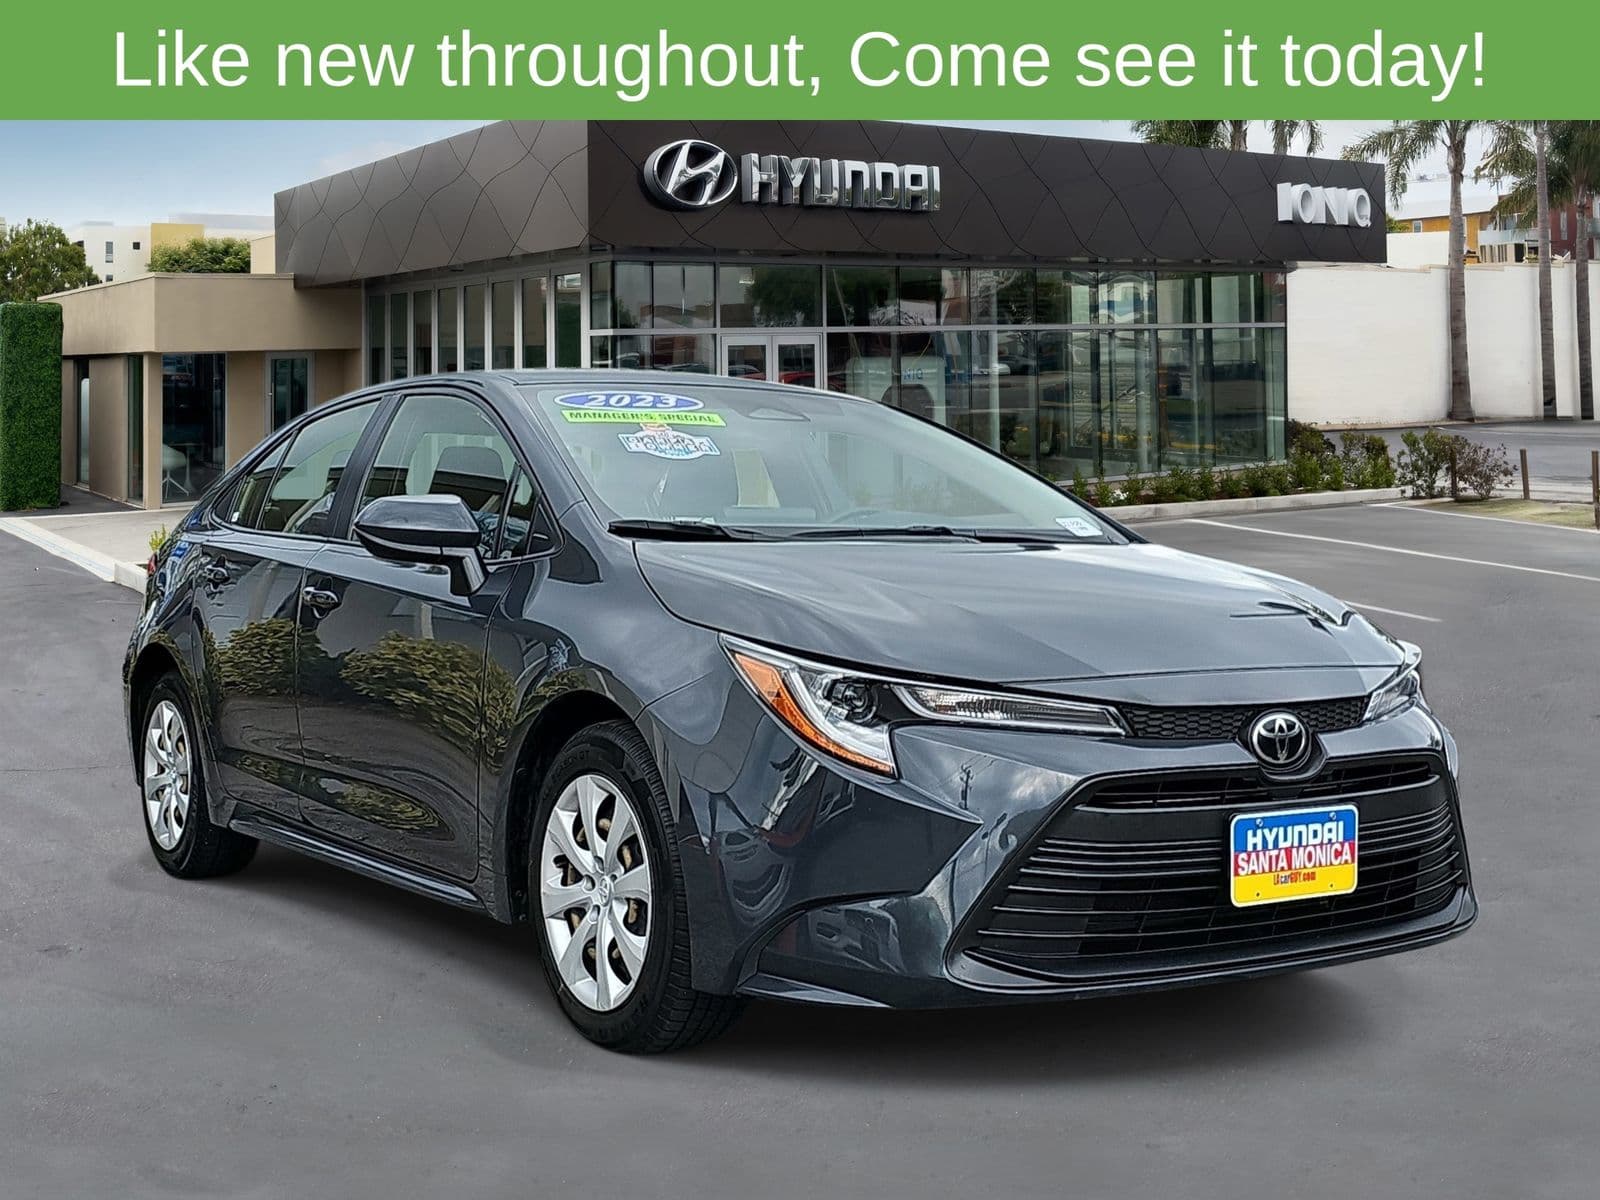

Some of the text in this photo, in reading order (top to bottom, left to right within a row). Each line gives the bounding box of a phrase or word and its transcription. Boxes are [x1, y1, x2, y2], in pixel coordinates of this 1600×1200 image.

[741, 153, 941, 211] HYUNDAI
[1277, 182, 1372, 228] IONIQ
[584, 394, 678, 408] 2023
[659, 413, 718, 424] SPECIAL
[1247, 820, 1344, 851] HYUNDAI
[1238, 841, 1352, 876] SANTA MONICA
